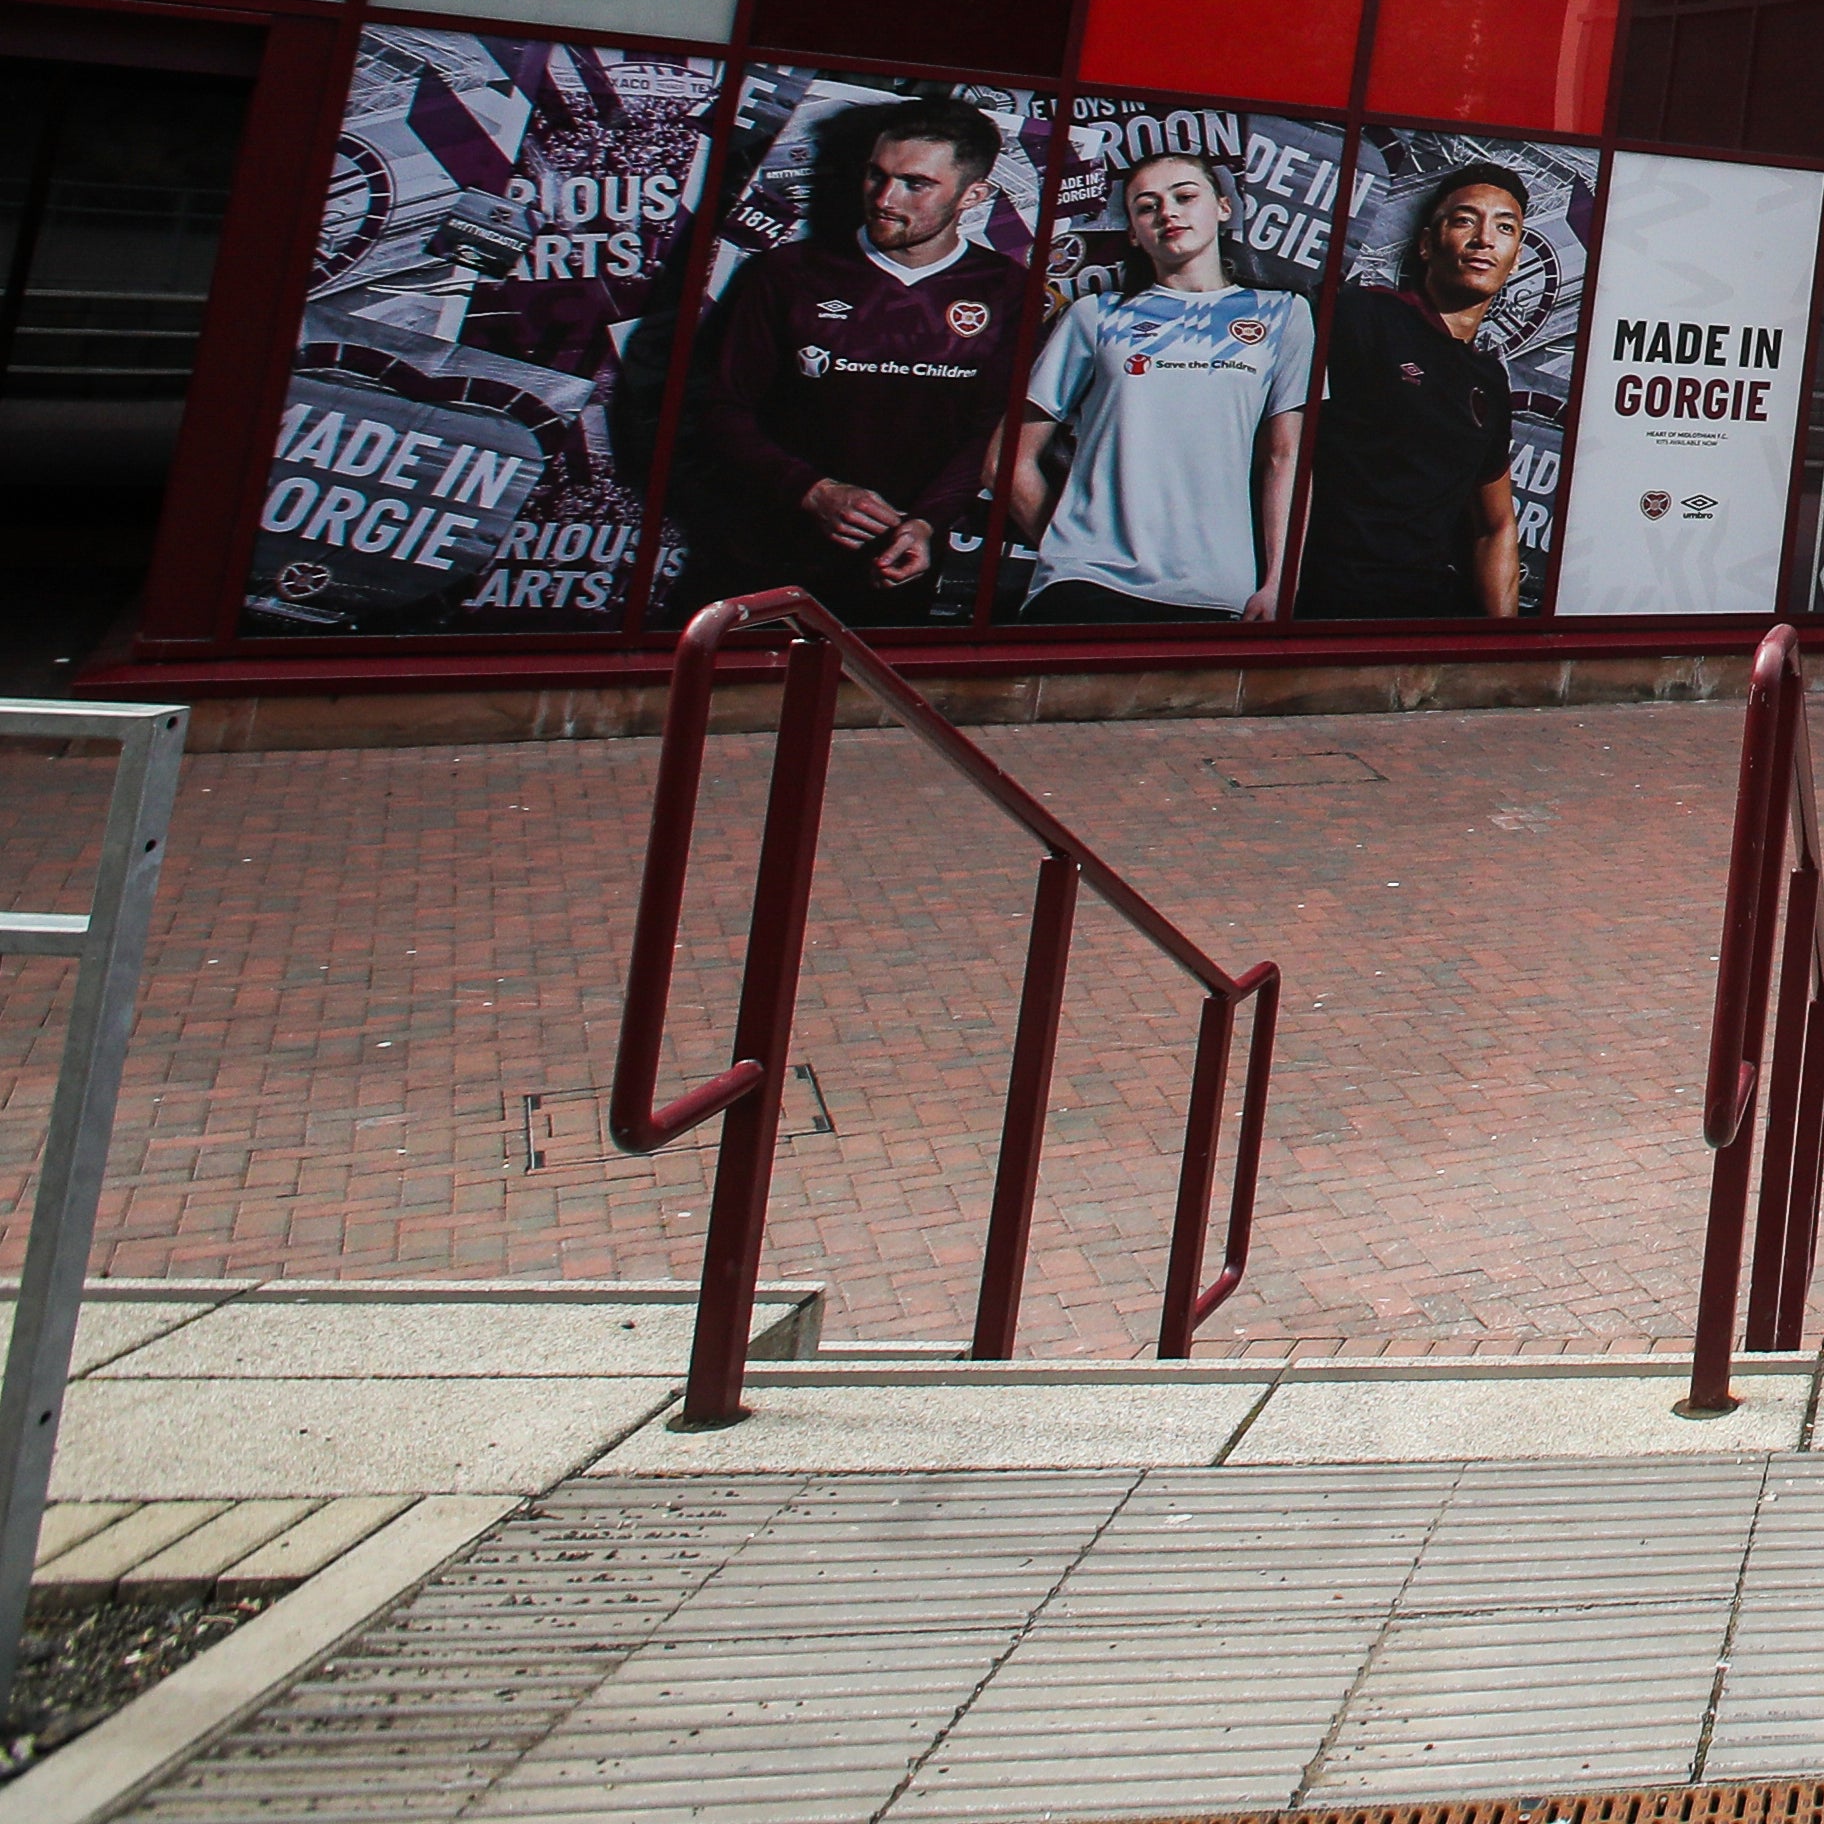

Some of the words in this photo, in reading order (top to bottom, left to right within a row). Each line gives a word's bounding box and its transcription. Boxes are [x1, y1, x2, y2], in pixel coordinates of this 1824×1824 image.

[1612, 318, 1731, 367] MADE
[1738, 326, 1784, 370] IN
[835, 356, 878, 374] Save
[880, 360, 910, 376] the
[913, 362, 978, 379] Children
[1155, 360, 1186, 370] Save
[1188, 360, 1209, 369] the
[1211, 360, 1257, 374] Children
[1615, 375, 1771, 422] GORGIE
[431, 443, 523, 510] IN
[1682, 510, 1714, 520] umbro
